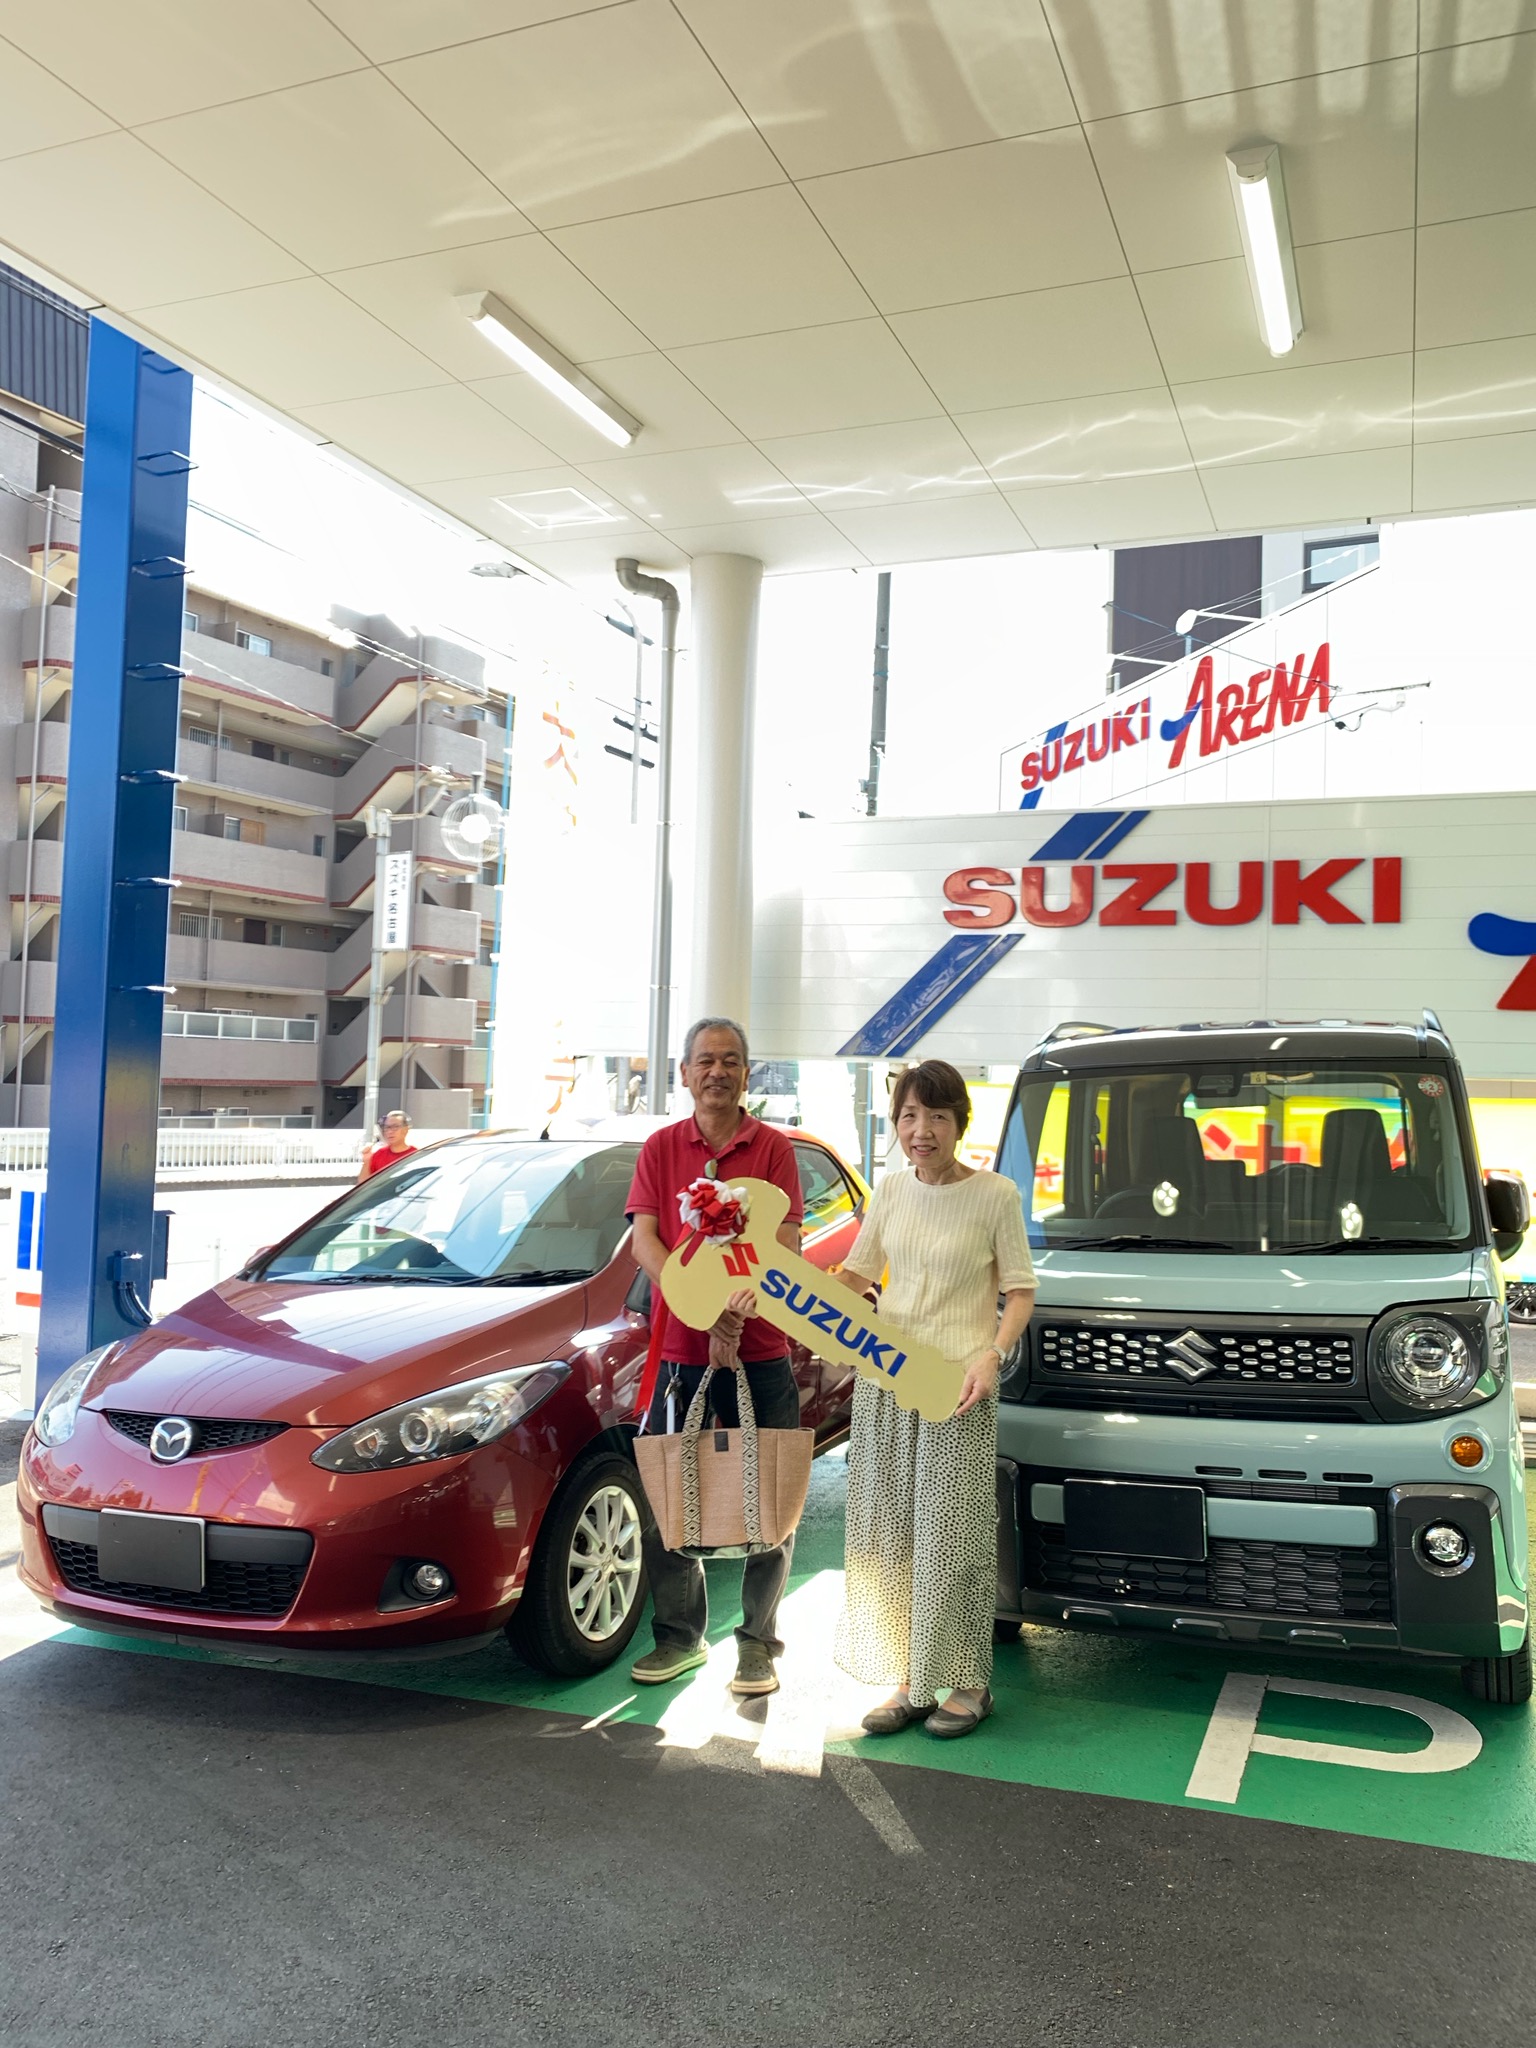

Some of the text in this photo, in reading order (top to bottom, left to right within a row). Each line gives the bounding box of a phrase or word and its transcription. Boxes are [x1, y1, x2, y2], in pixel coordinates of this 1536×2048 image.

[1020, 642, 1332, 791] SUZUKI ARENA
[942, 857, 1403, 929] SUZUKI
[759, 1268, 908, 1378] SUZUKI
[1184, 1671, 1484, 1804] P
